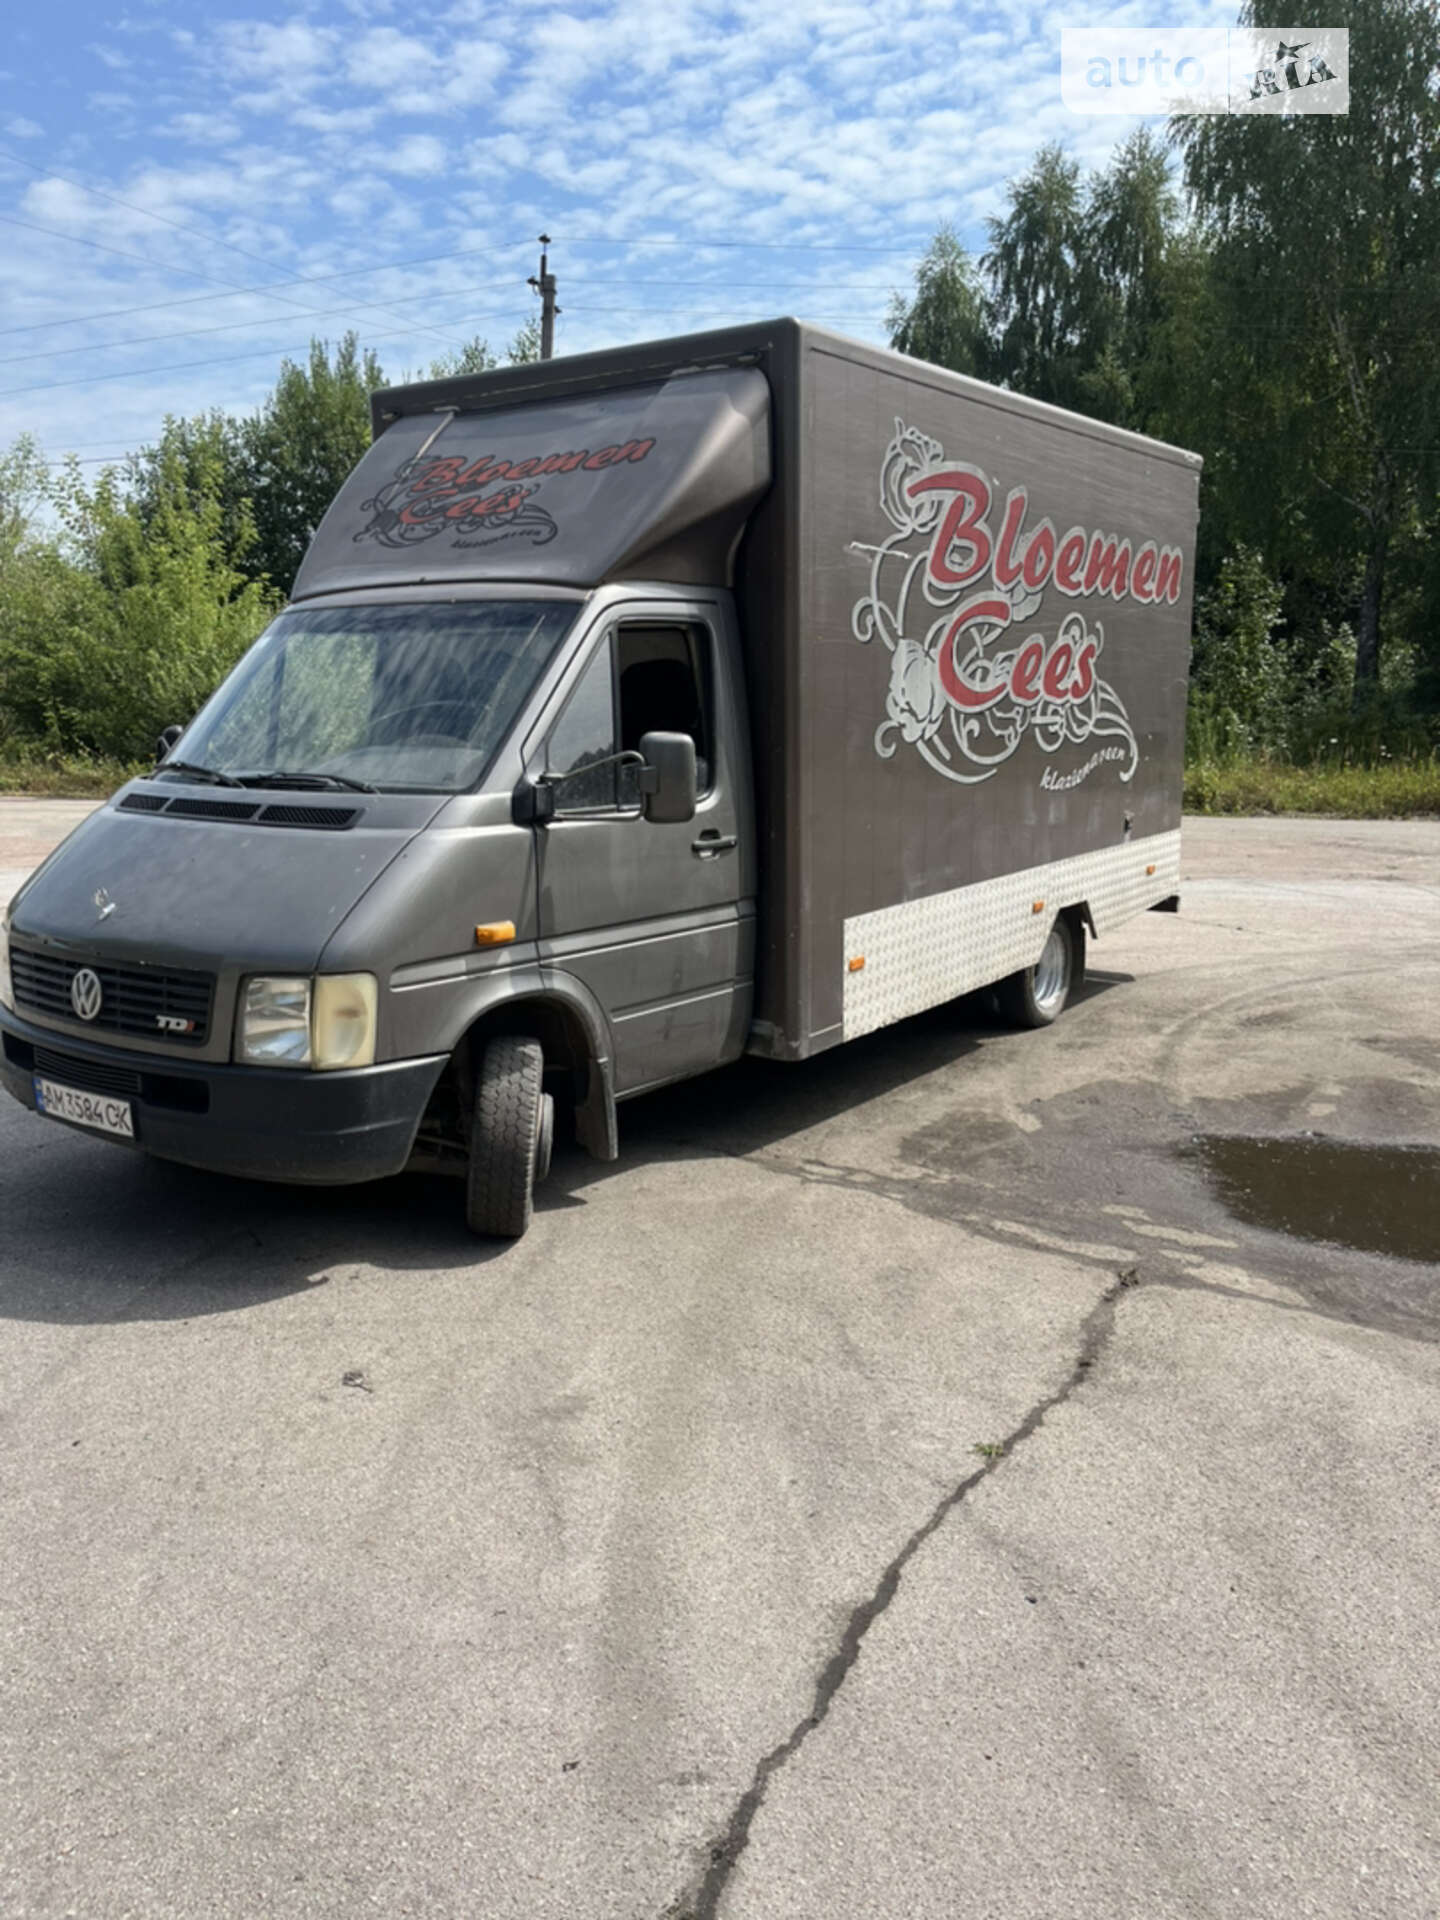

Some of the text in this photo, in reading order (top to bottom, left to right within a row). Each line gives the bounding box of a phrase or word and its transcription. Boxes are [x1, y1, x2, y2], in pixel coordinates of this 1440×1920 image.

[398, 487, 534, 525] Cees
[406, 437, 656, 495] Bloemen
[905, 460, 1184, 605] Bloemen
[936, 592, 1099, 712] Cees
